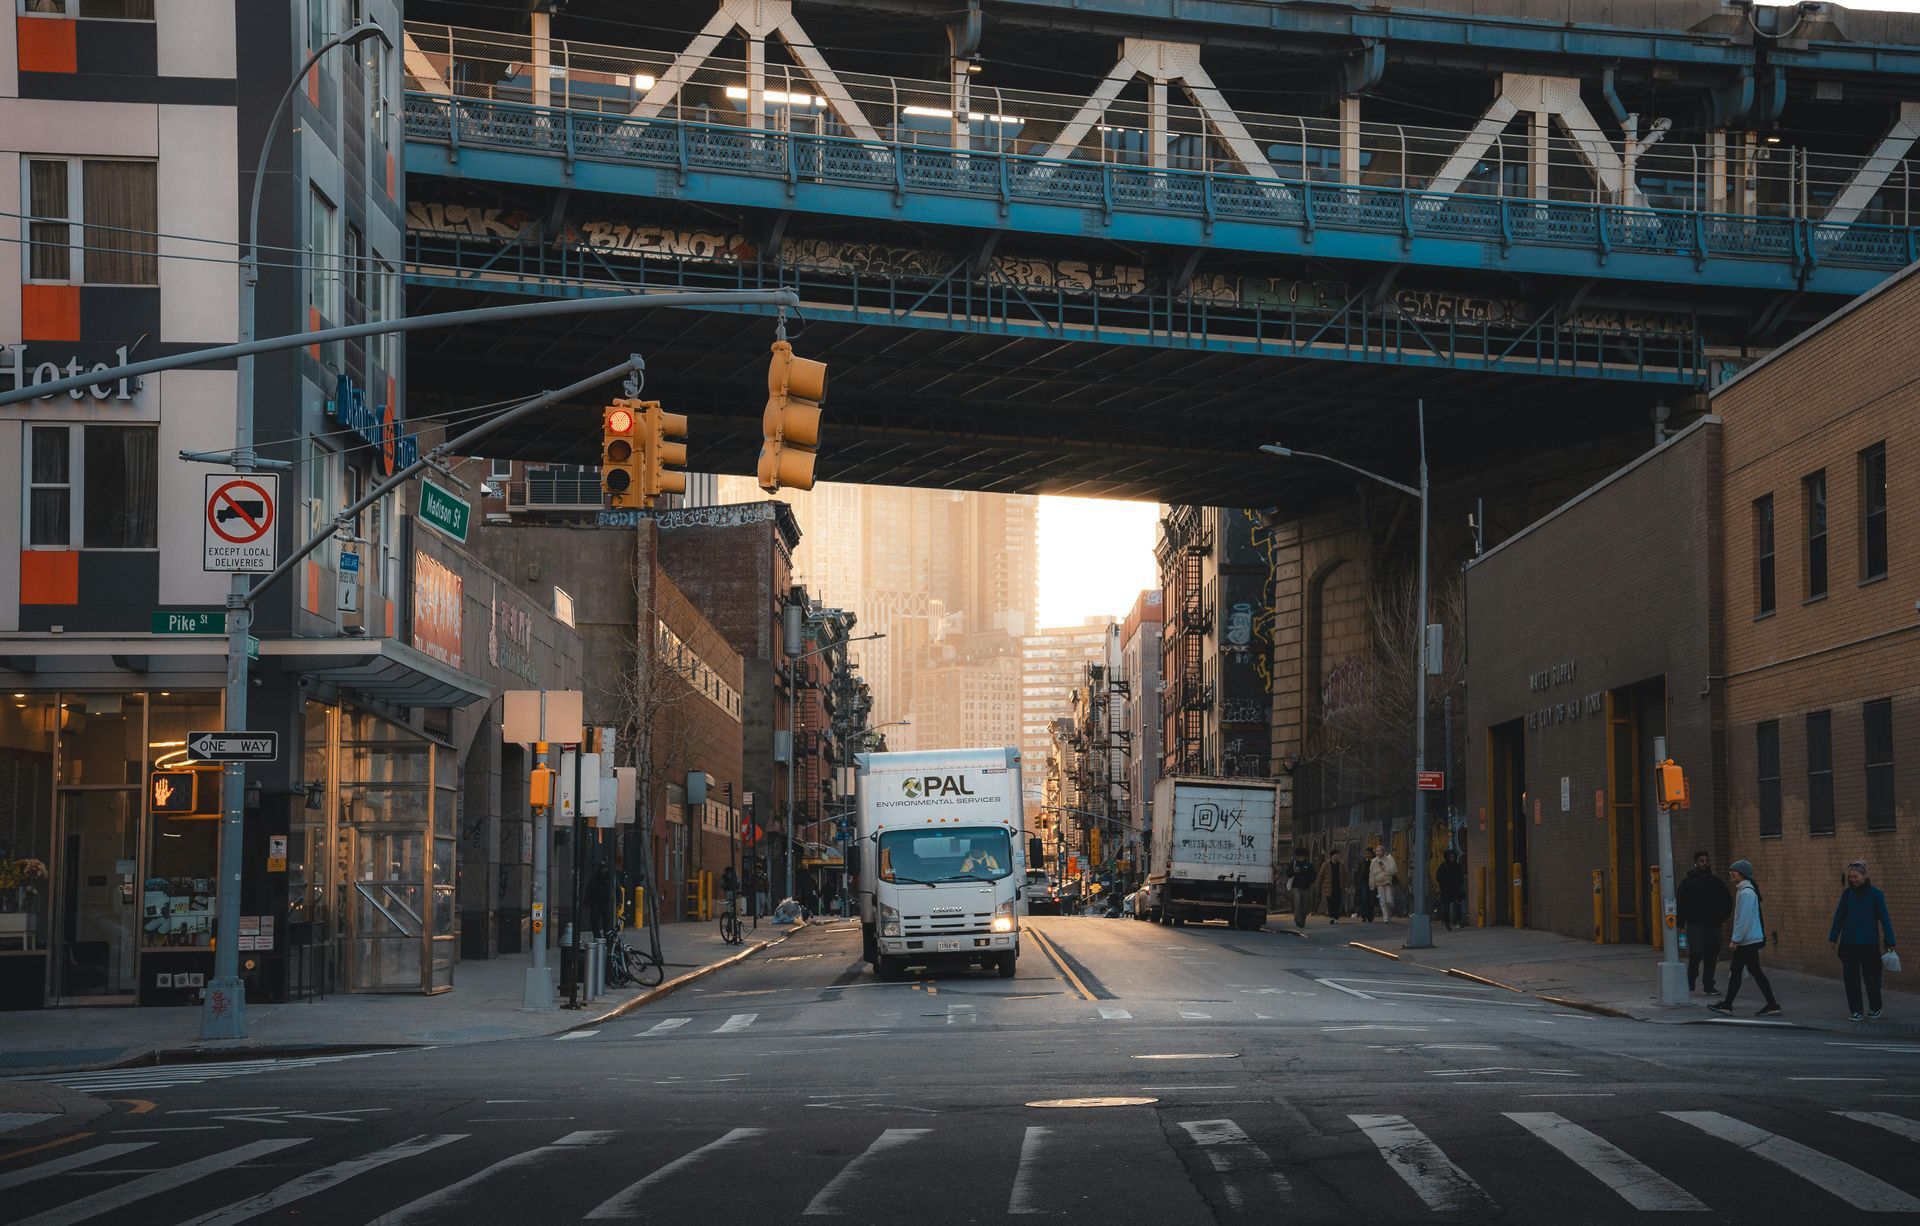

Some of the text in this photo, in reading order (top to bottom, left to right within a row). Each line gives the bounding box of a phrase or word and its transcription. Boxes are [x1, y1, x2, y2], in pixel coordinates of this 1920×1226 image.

[0, 344, 132, 400] Hotel
[427, 491, 461, 529] Madison St
[208, 547, 271, 557] EXCEPT LOCAL
[215, 558, 264, 568] DELIVERIES
[169, 614, 208, 631] Pike St
[1529, 656, 1576, 691] WATER SUPPLY
[1555, 703, 1565, 722] OF
[200, 741, 269, 752] ONE WAY
[924, 775, 975, 797] PAL
[876, 796, 1001, 808] ENVIRONMENTAL SERVICES
